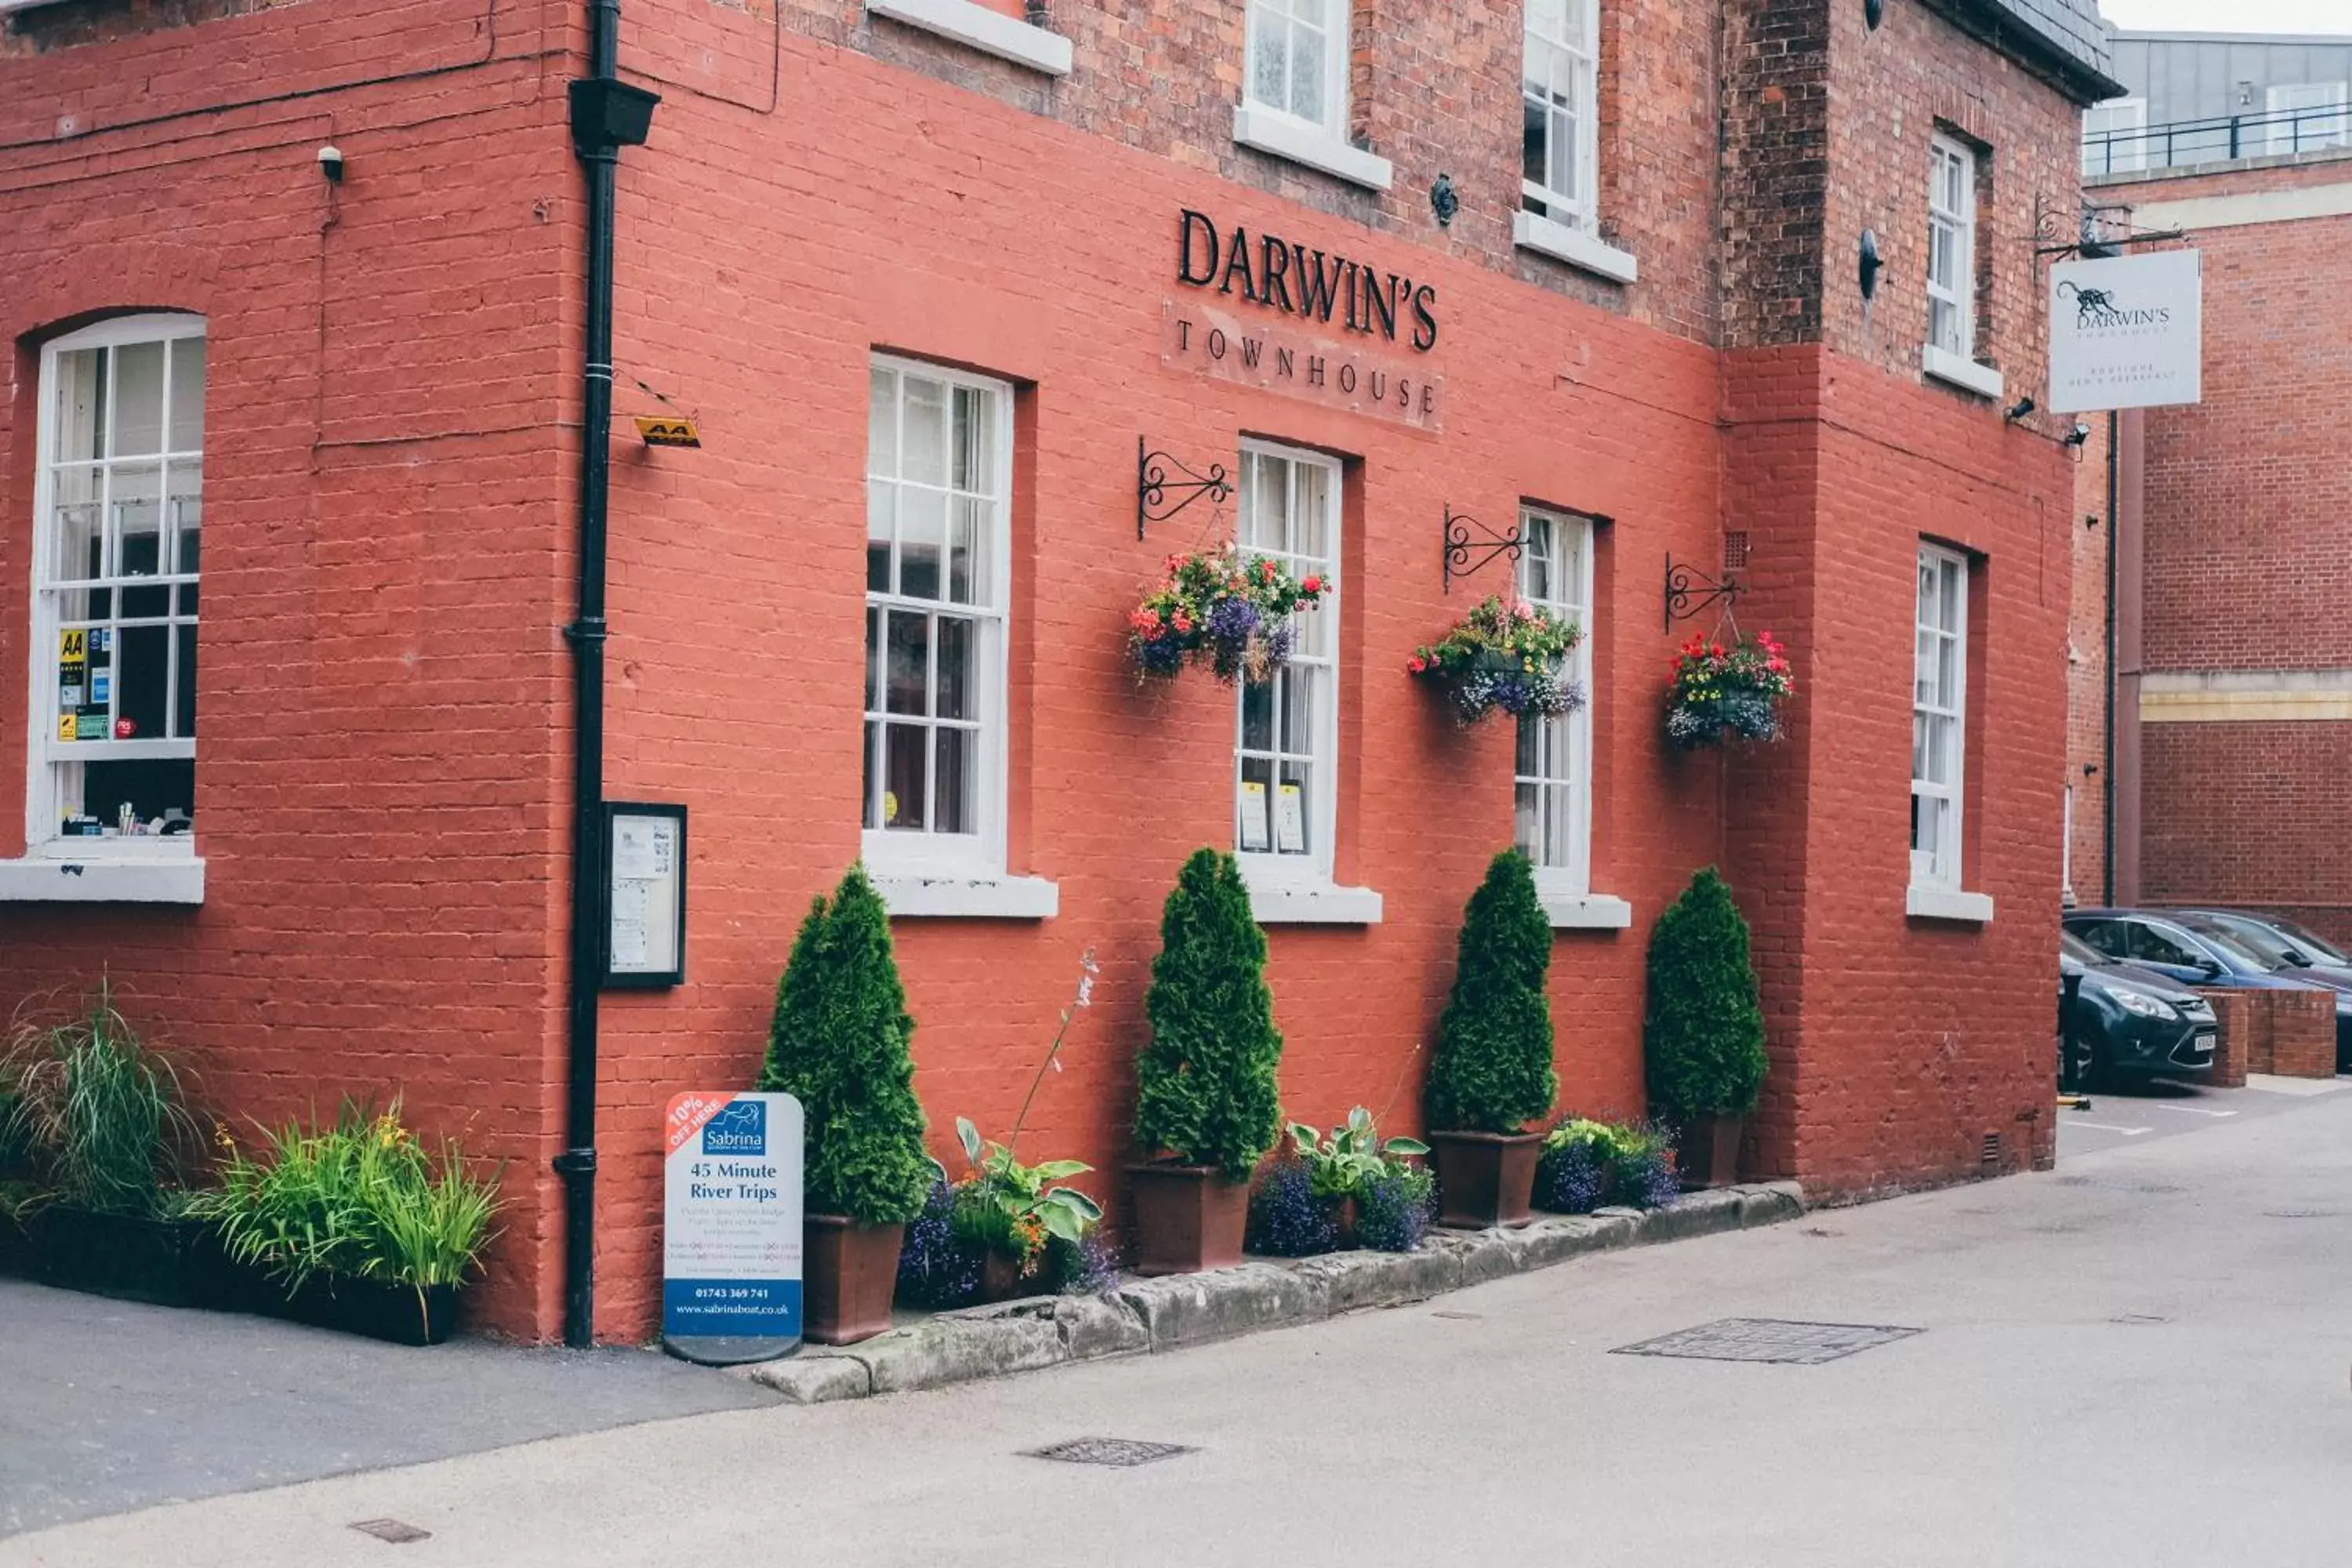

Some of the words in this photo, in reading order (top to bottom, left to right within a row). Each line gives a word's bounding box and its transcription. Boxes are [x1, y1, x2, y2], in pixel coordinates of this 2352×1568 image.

[1178, 208, 1437, 352] DARWIN'S
[2076, 307, 2170, 329] DARWIN'S
[1178, 319, 1435, 414] TOWNHOUSE
[648, 424, 689, 435] AA
[63, 633, 82, 656] AA
[668, 1094, 703, 1127] 10%
[670, 1123, 691, 1146] OFF
[690, 1098, 721, 1128] HERE
[707, 1130, 762, 1146] Sabrina
[691, 1163, 711, 1178] 45
[717, 1162, 778, 1178] Minute
[691, 1183, 733, 1200] River
[738, 1183, 778, 1203] Trips
[695, 1288, 728, 1299] 01743
[729, 1288, 749, 1299] 369
[750, 1288, 768, 1299] 741
[676, 1303, 789, 1316] www.sabrinaboat.co.uk
